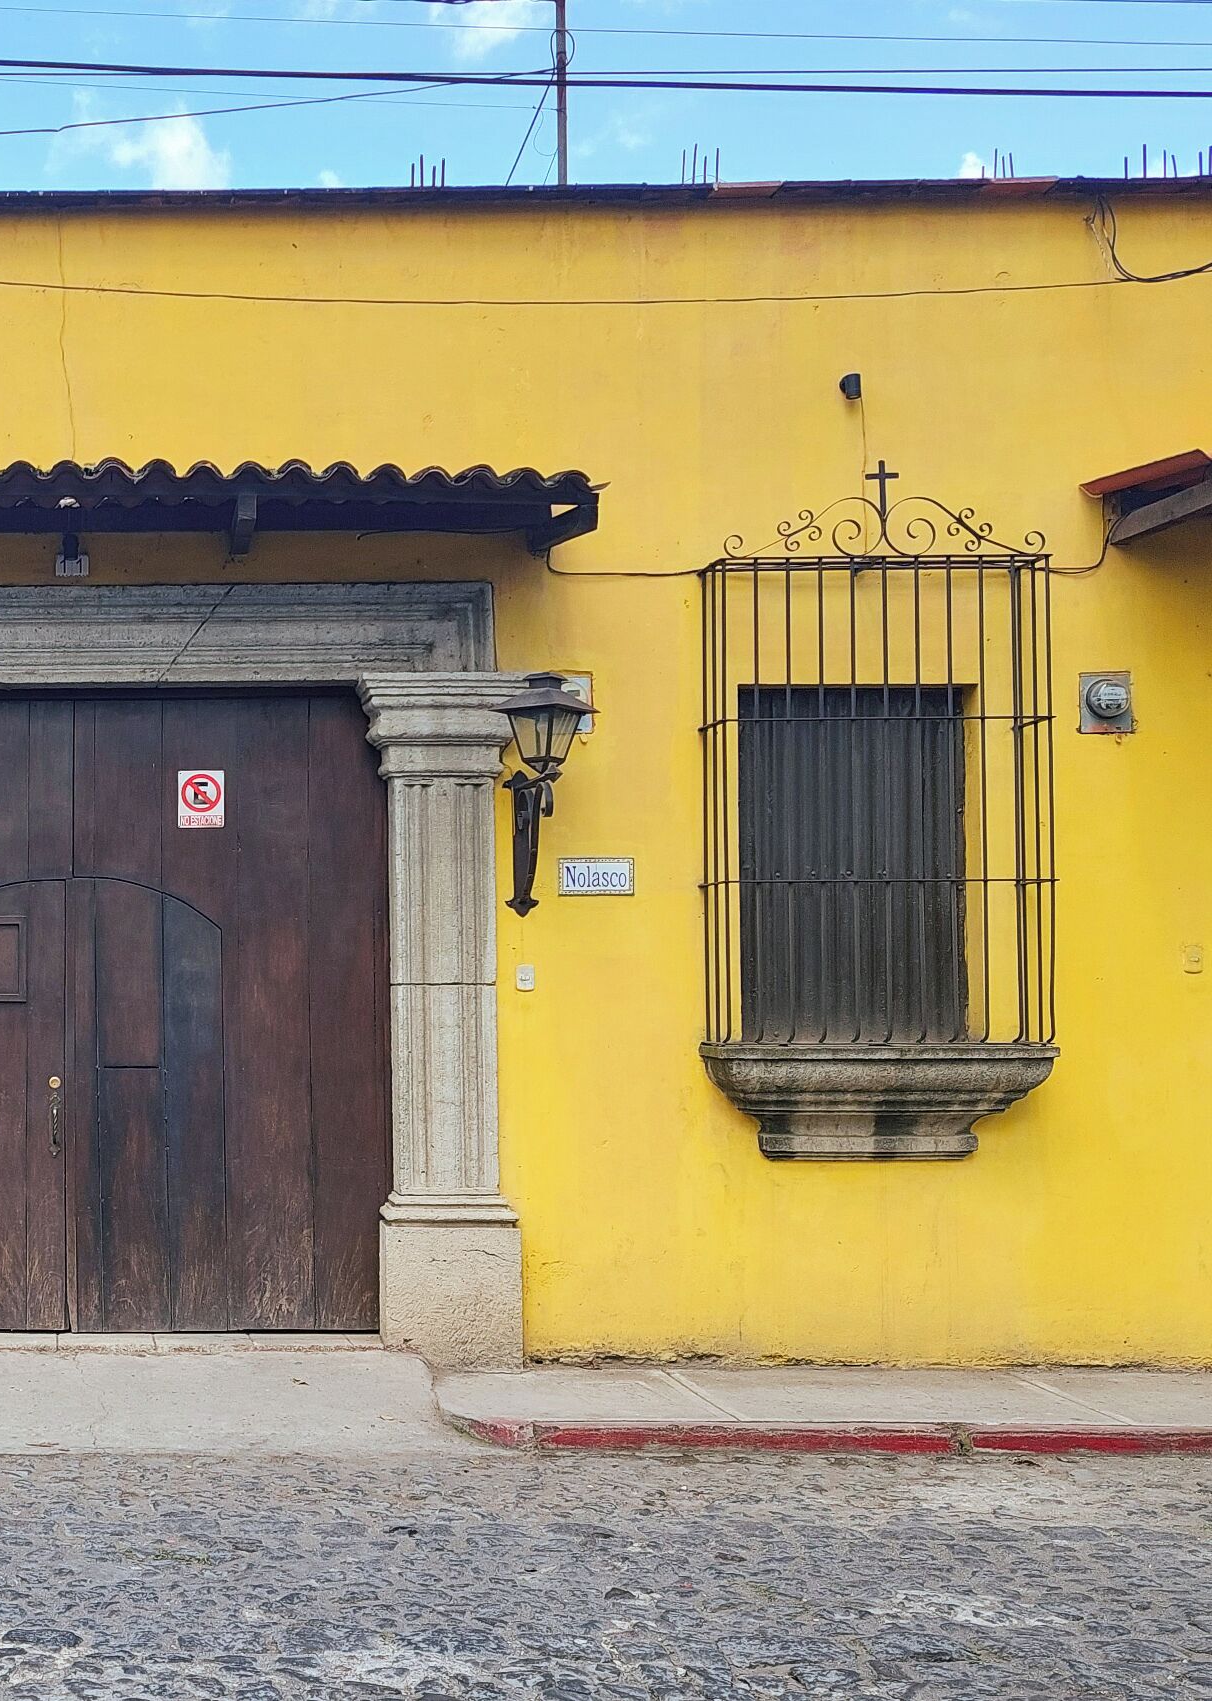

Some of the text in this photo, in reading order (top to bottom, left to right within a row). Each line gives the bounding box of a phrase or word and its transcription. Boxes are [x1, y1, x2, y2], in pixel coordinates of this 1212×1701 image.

[193, 781, 210, 805] E
[180, 815, 222, 826] NO ESTACIONE
[564, 865, 627, 888] Nolasco
